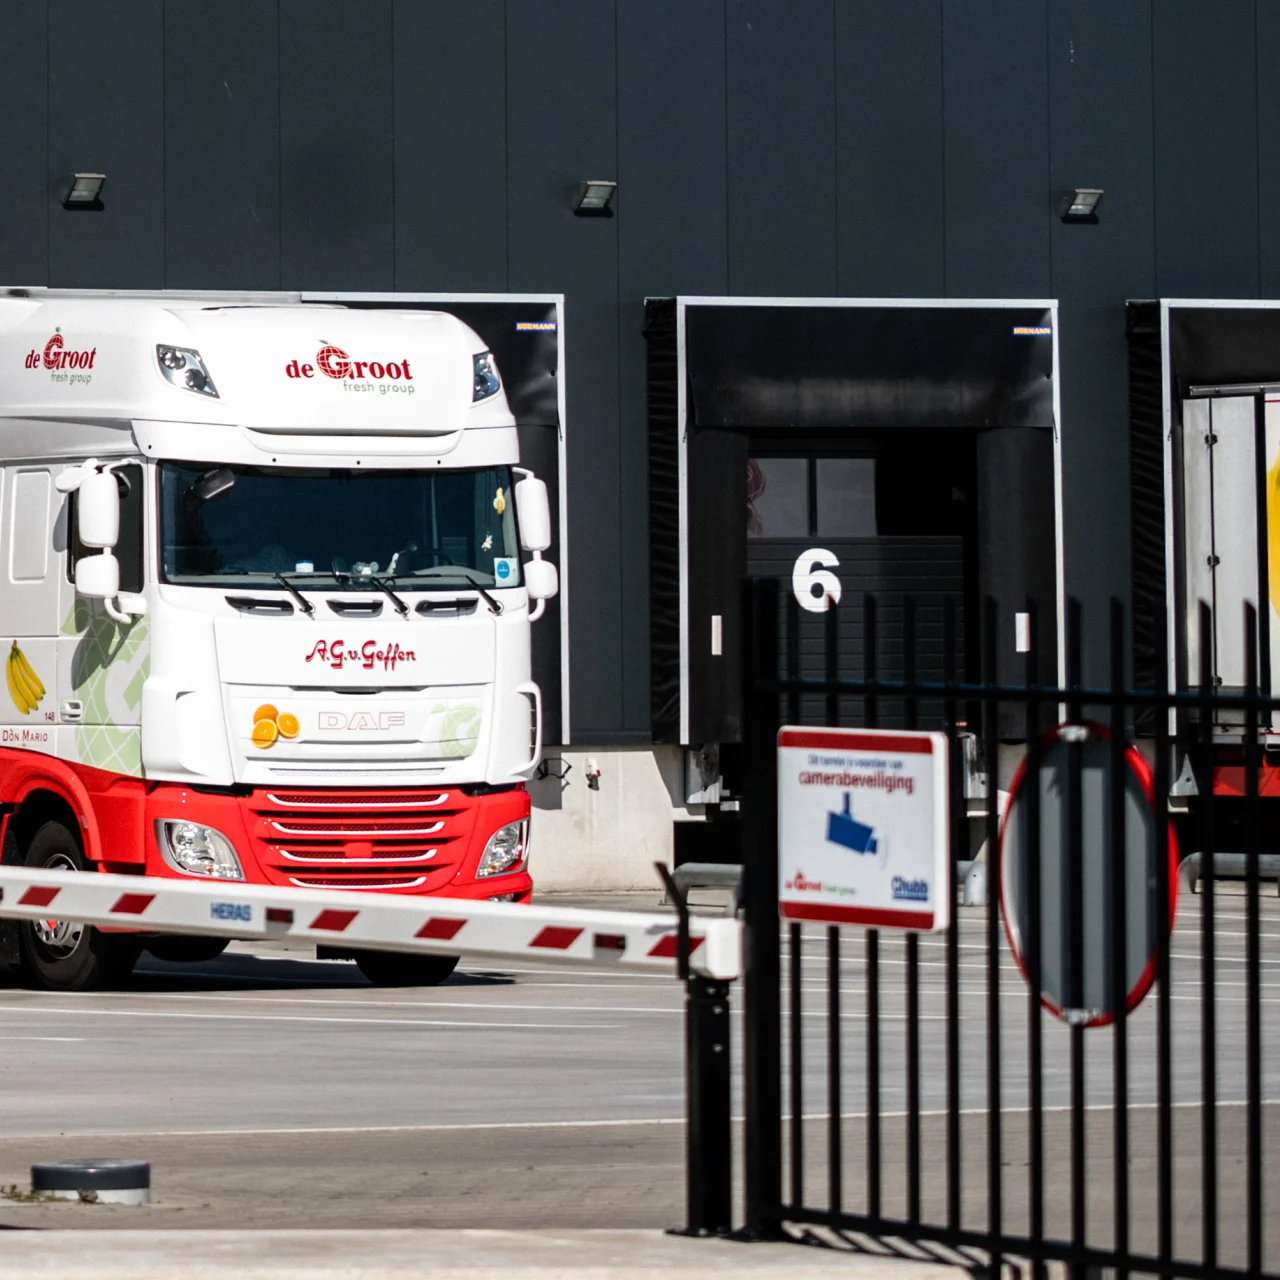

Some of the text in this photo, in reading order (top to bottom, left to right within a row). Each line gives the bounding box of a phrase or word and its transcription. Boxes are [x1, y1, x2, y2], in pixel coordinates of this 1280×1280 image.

[25, 334, 96, 370] de Groot
[286, 345, 413, 380] de Groot
[70, 374, 92, 386] group
[343, 380, 415, 395] fresh group
[792, 548, 841, 612] 6
[318, 712, 405, 730] DAF
[799, 770, 914, 794] camerabeveiliging
[892, 876, 928, 893] Chubb
[211, 902, 252, 922] HERAS
